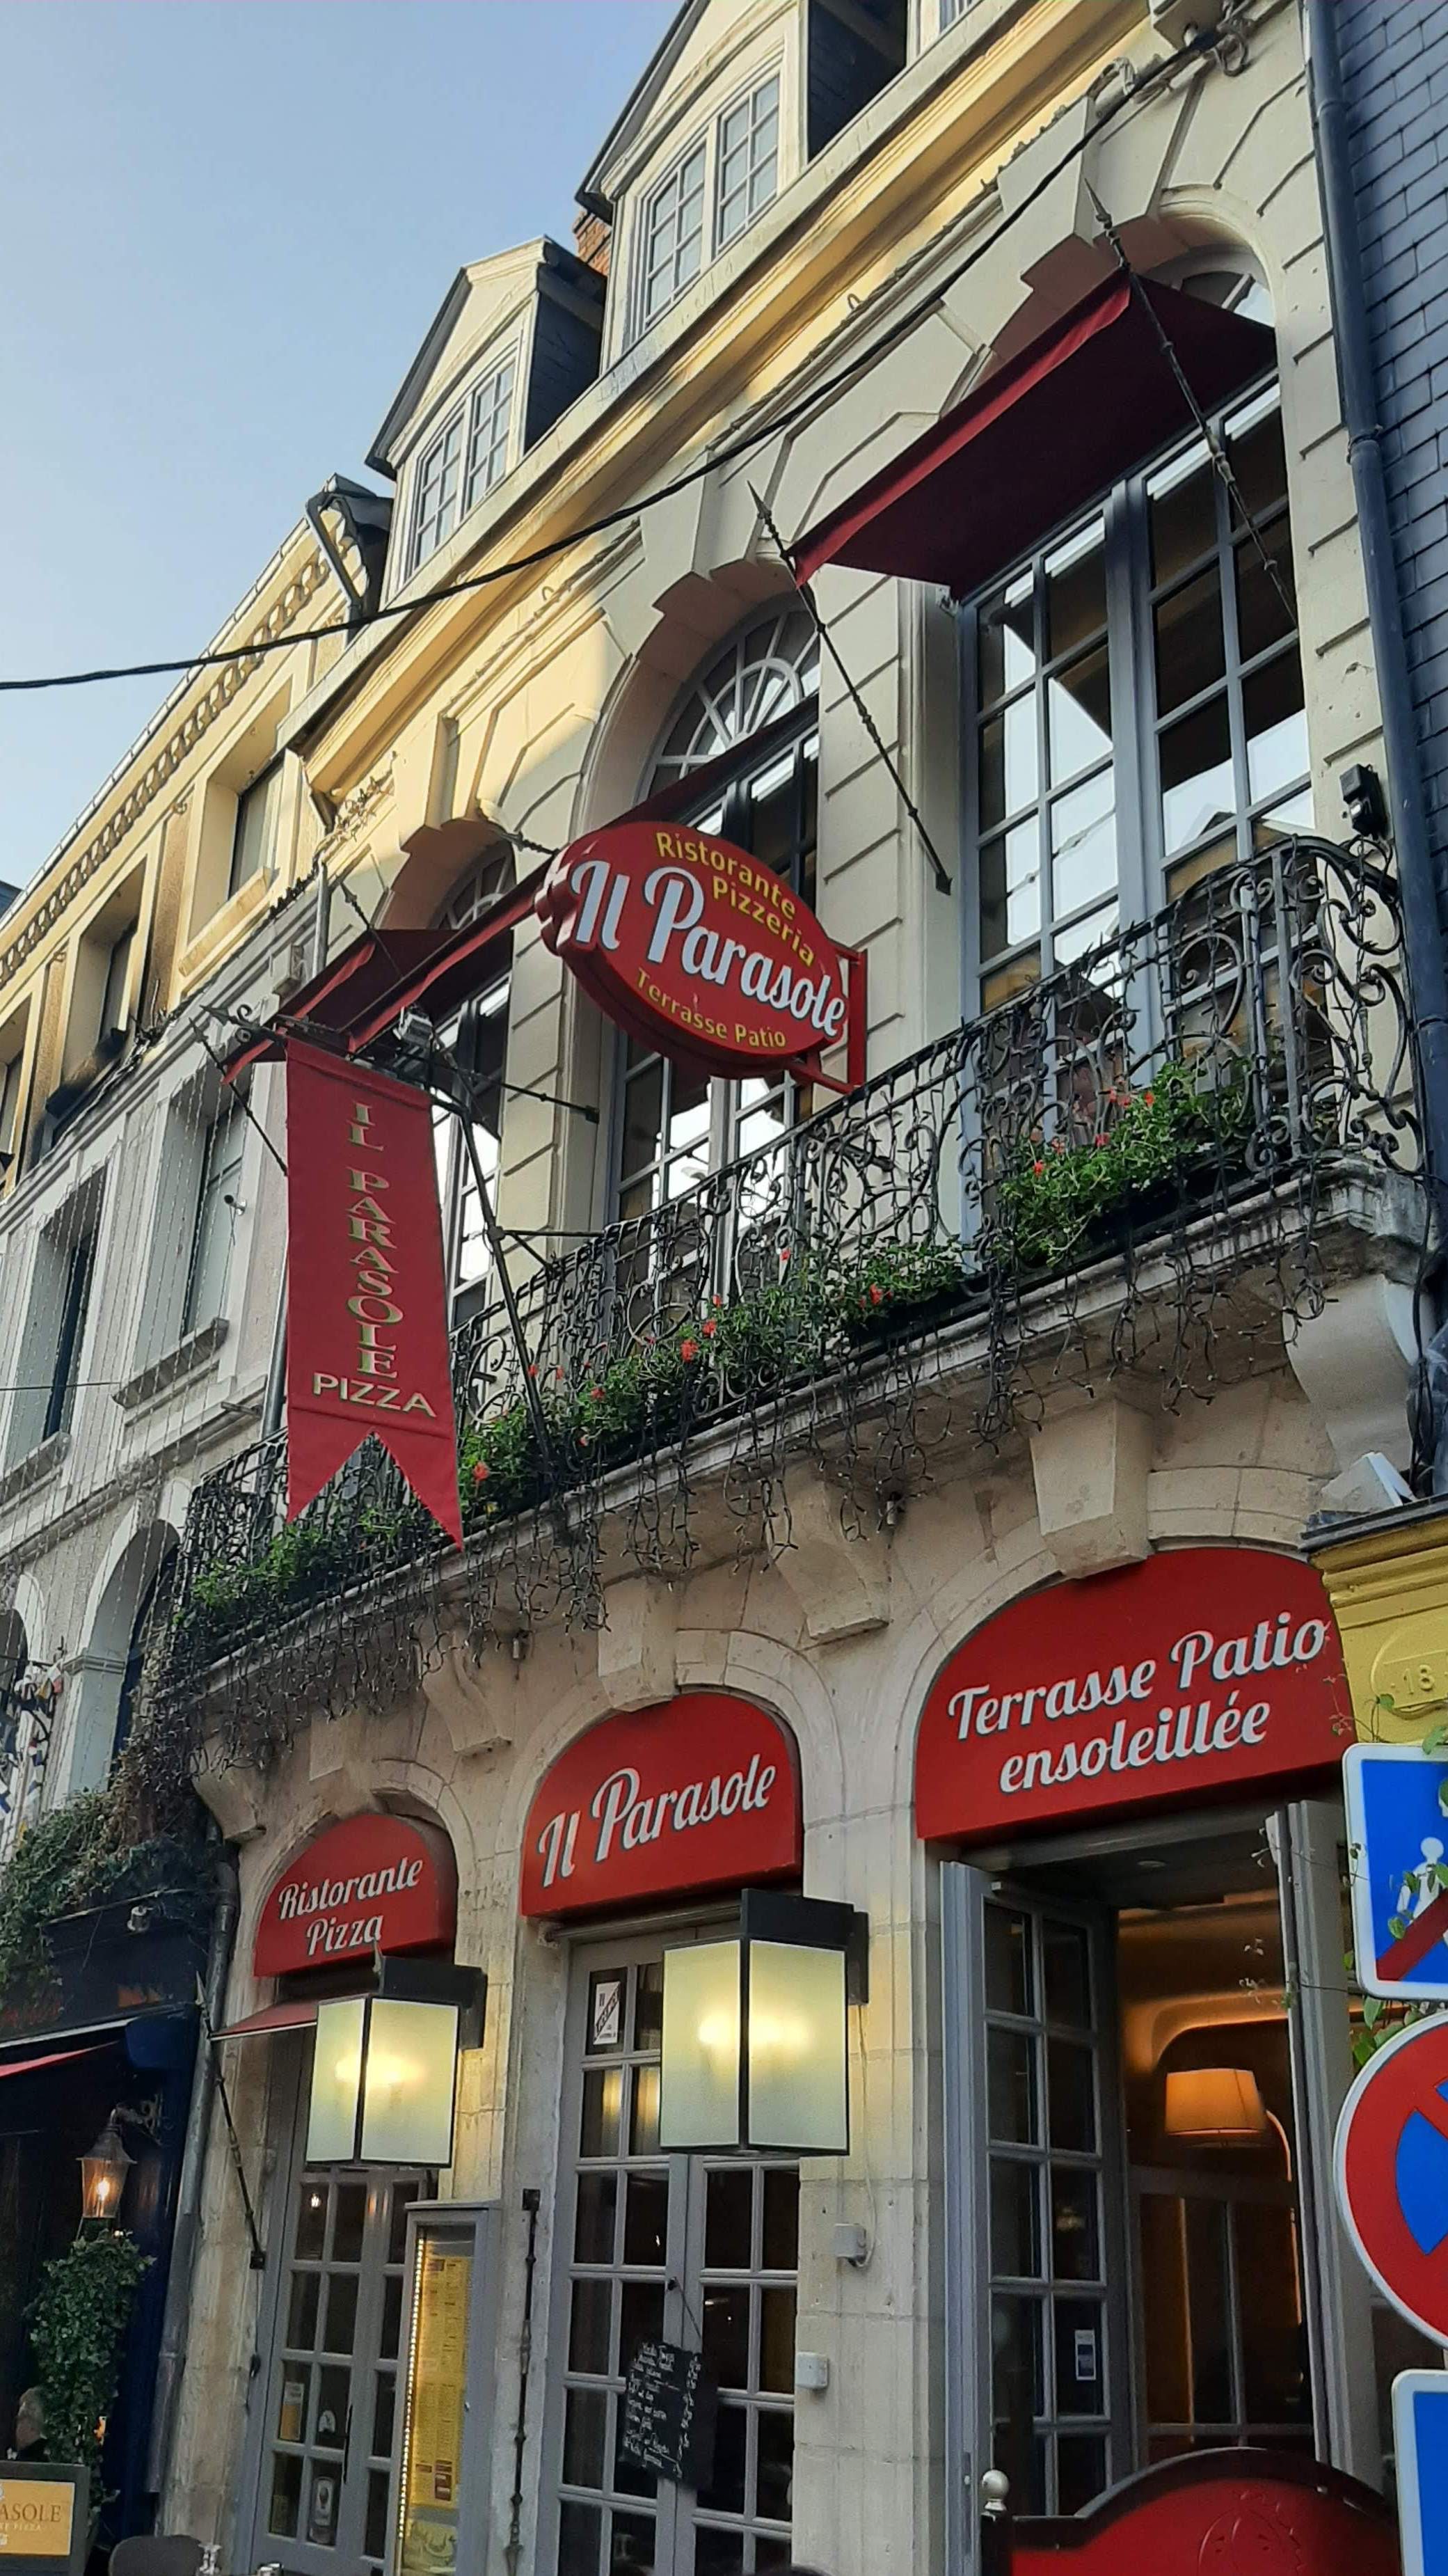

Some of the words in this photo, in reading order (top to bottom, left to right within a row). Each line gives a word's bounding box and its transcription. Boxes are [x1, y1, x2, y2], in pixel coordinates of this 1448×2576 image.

[655, 832, 796, 920] Ristorante
[712, 875, 815, 966] Pizzeria
[570, 860, 630, 951] Il
[644, 866, 846, 1038] Parasole
[637, 967, 727, 1040] Terrasse
[735, 1023, 786, 1048] Patio
[348, 1102, 383, 1151] IL
[347, 1167, 404, 1378] PARASOLE
[313, 1373, 437, 1417] PIZZA
[947, 1659, 1157, 1740] Terrasse
[1170, 1611, 1332, 1689] Patio
[999, 1689, 1271, 1794] ensoleillée
[538, 1810, 581, 1888] Il
[591, 1753, 777, 1863] Parasole
[278, 1856, 423, 1920] Ristorante
[306, 1915, 384, 1956] Pizza
